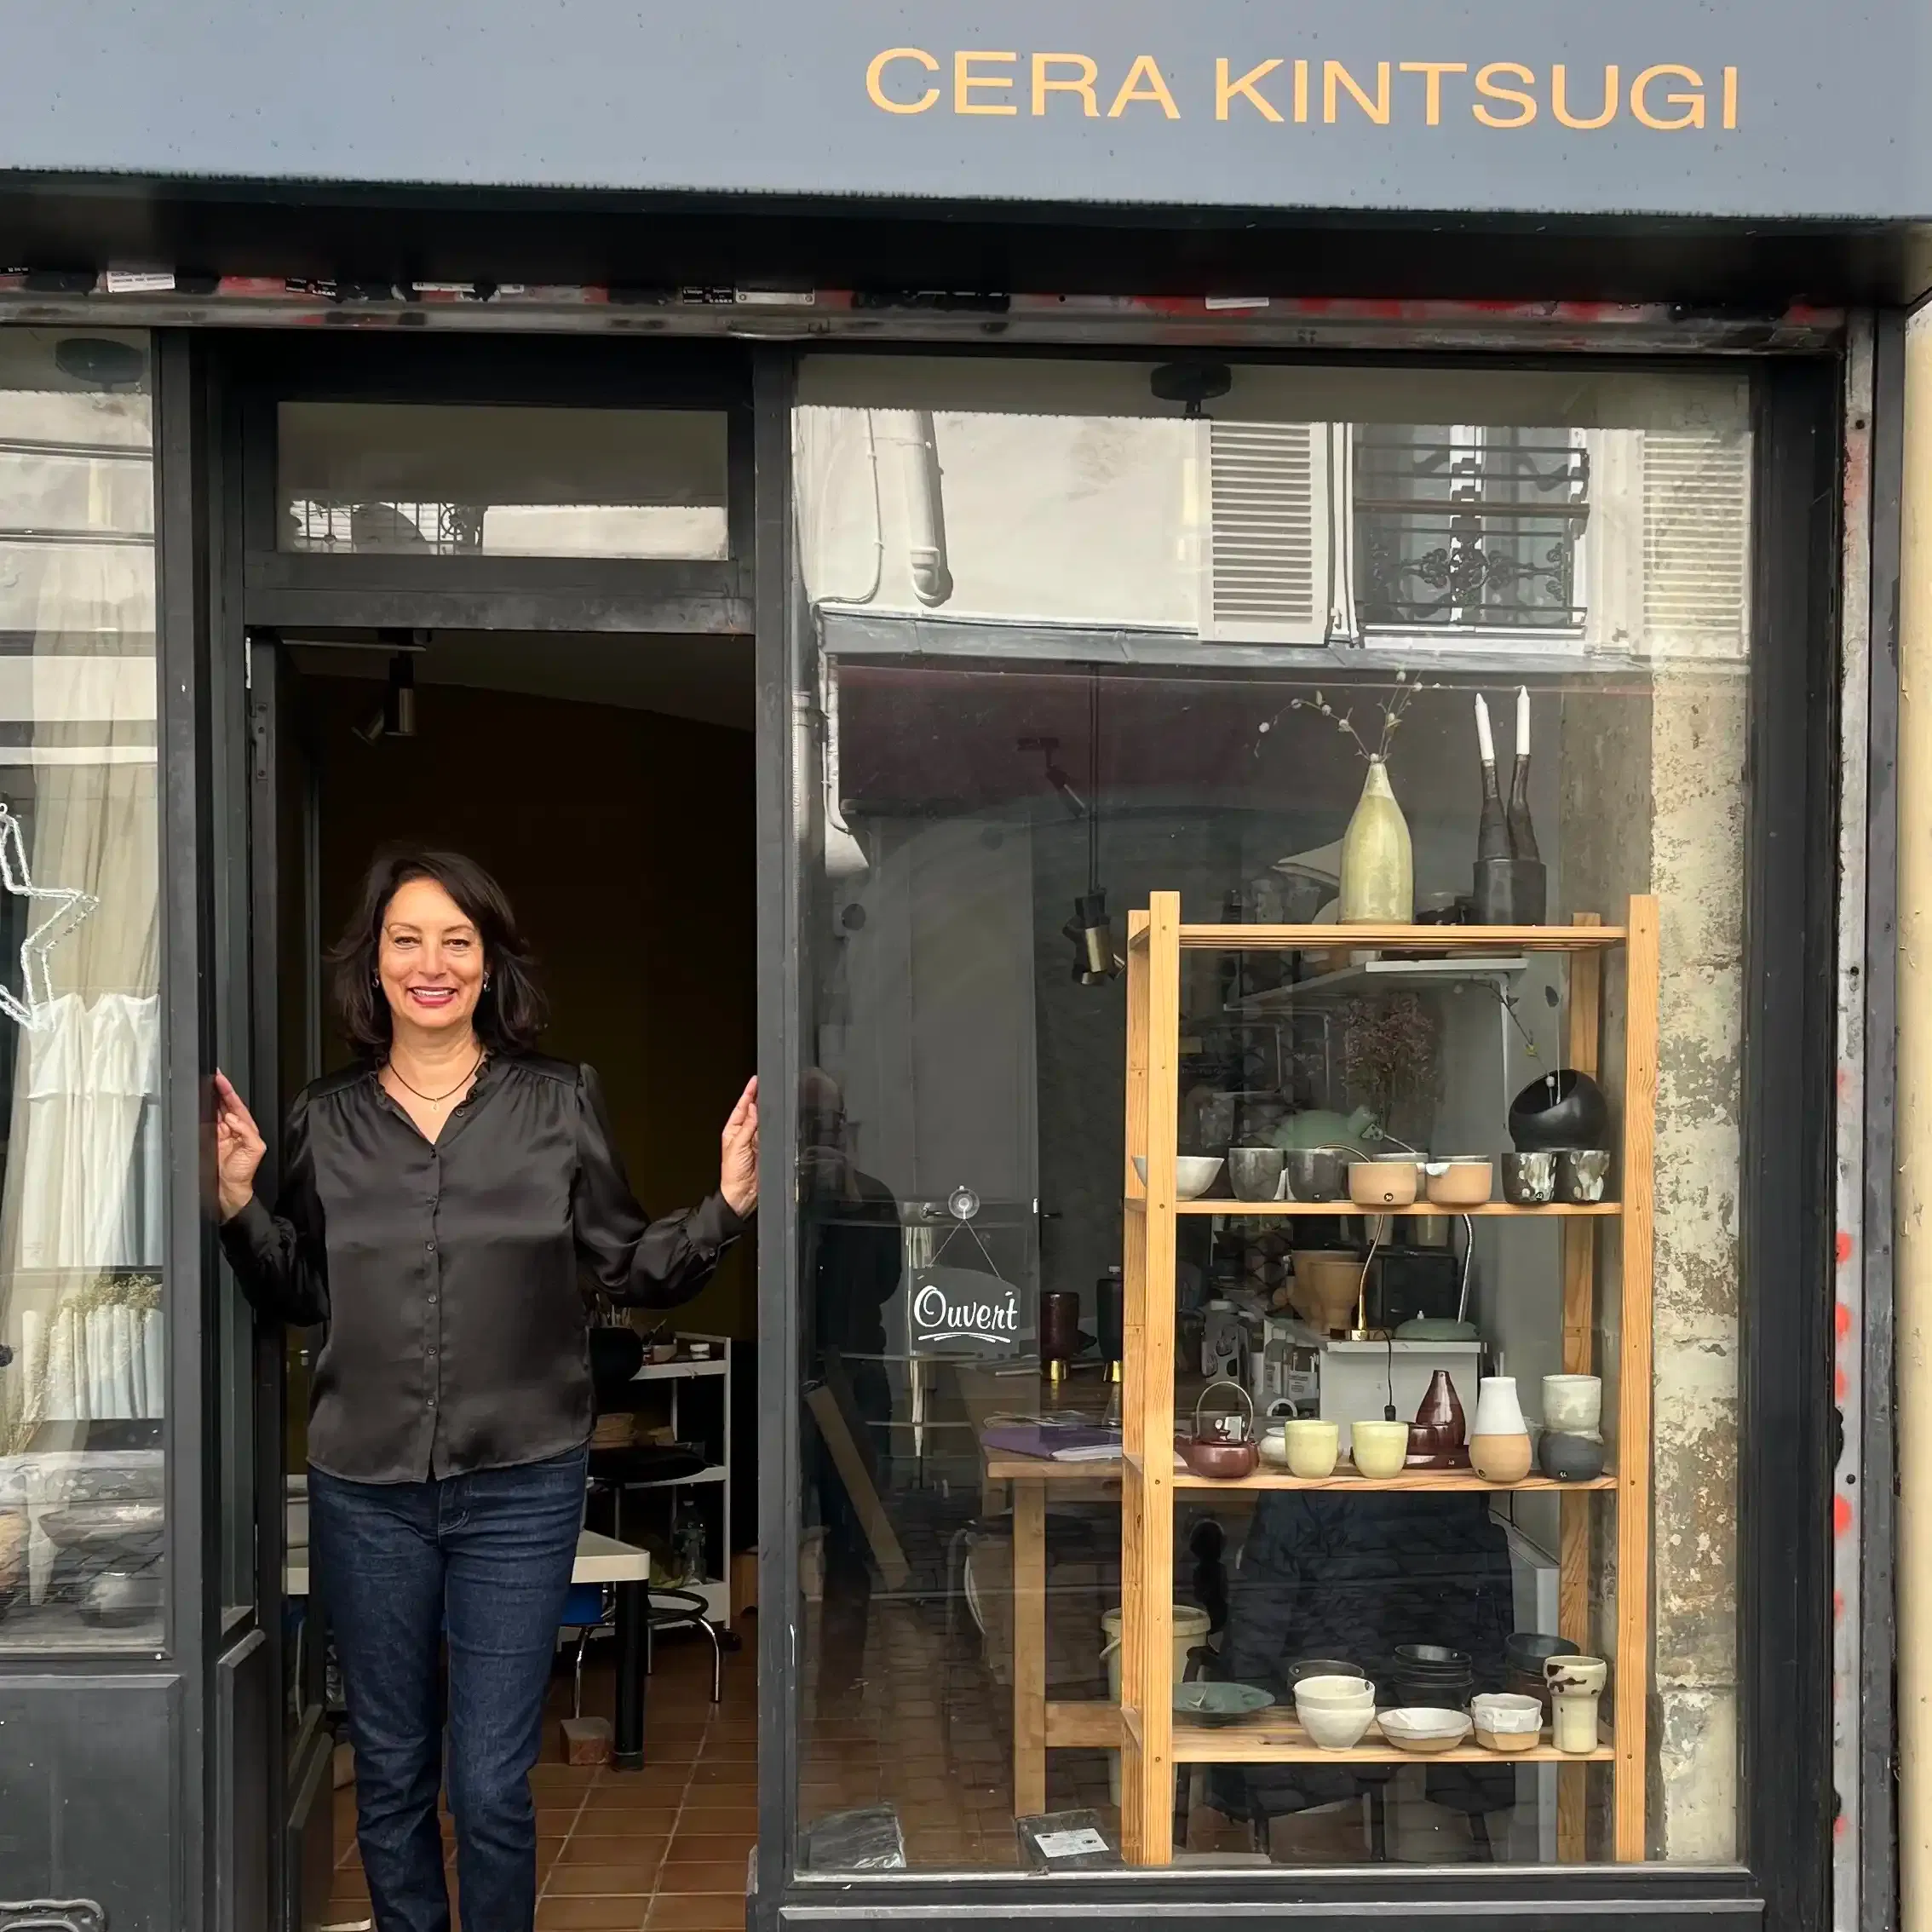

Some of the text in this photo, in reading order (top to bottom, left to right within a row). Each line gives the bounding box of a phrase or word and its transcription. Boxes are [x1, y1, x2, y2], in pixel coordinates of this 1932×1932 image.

[865, 48, 1739, 131] CERA KINTSUGI
[913, 1285, 1019, 1331] Ouvert
